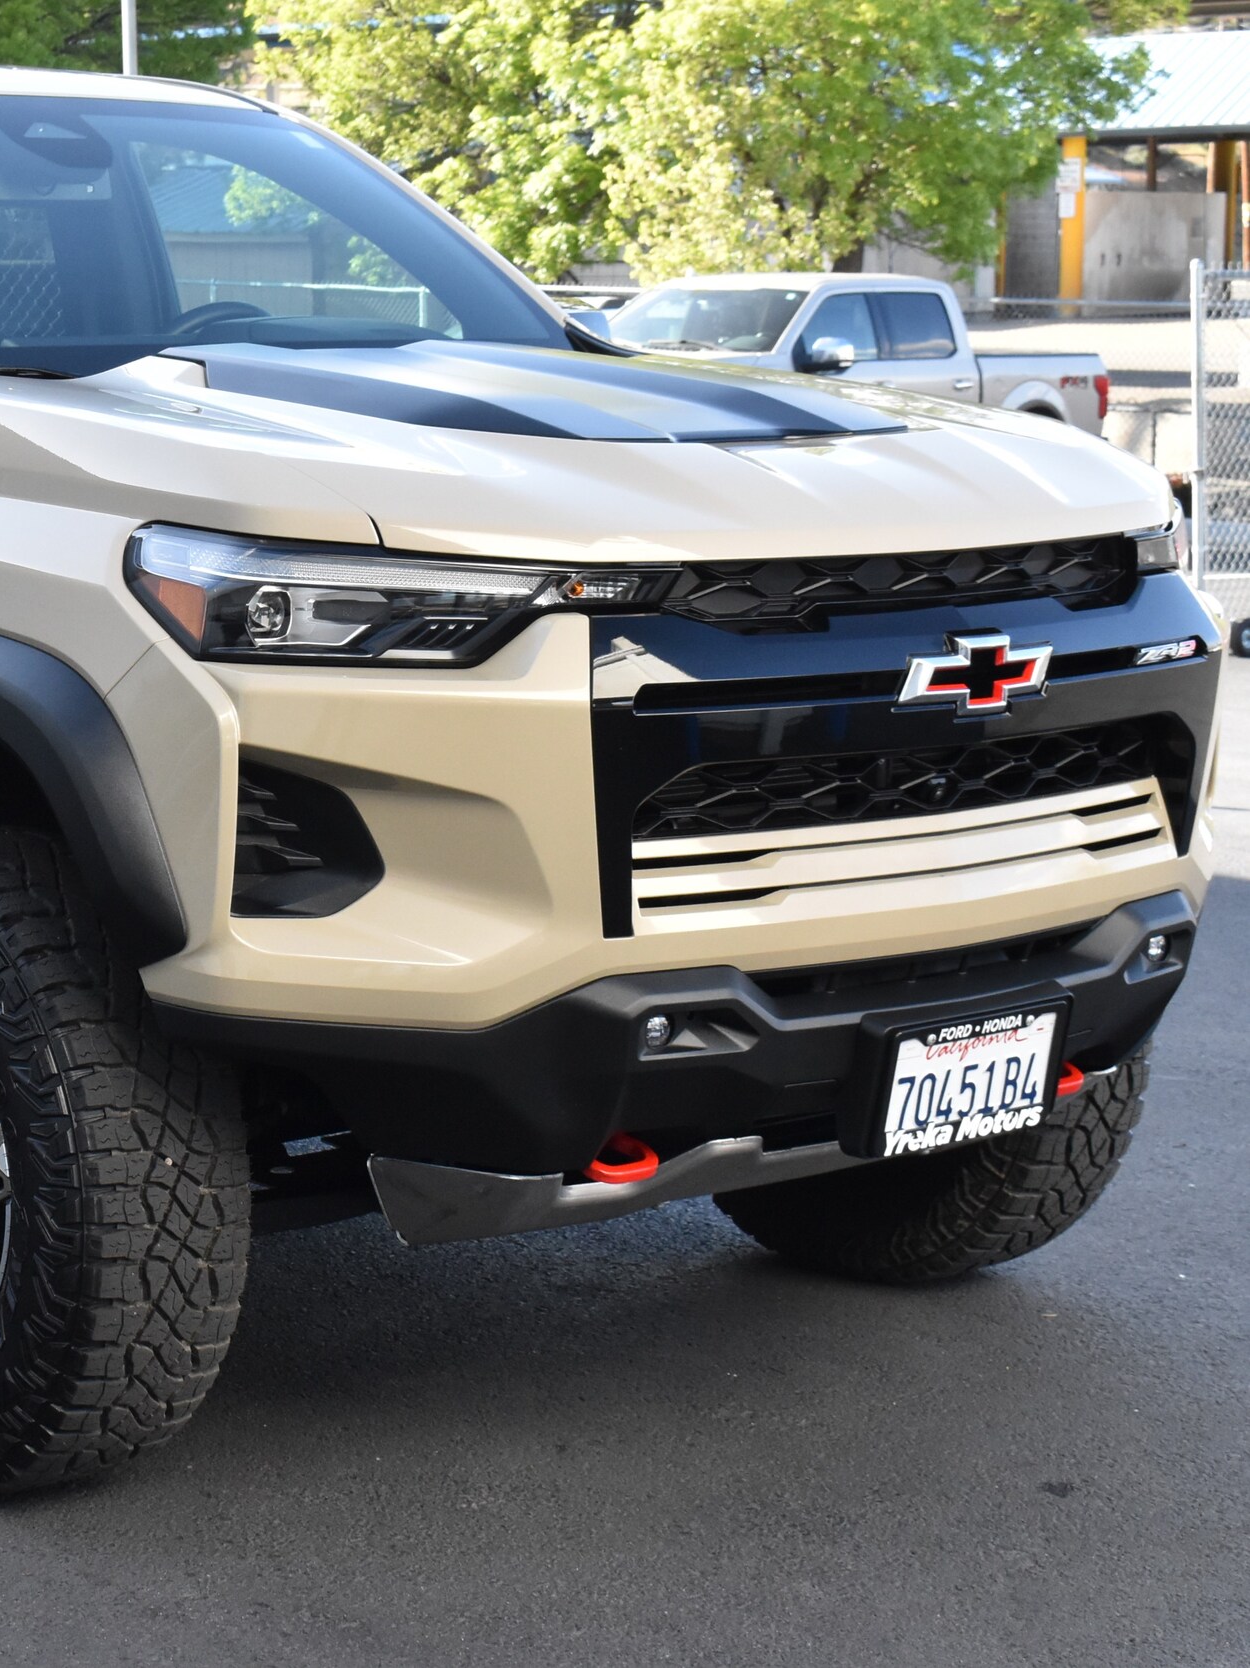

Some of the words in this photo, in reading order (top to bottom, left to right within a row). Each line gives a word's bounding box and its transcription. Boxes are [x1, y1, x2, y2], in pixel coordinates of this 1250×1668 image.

[1136, 639, 1197, 665] ZR2
[938, 1024, 973, 1042] FORD
[981, 1014, 1023, 1034] HONDA
[897, 1053, 1037, 1130] 70451B4
[883, 1121, 954, 1157] Yreka
[955, 1105, 1044, 1142] Motors
